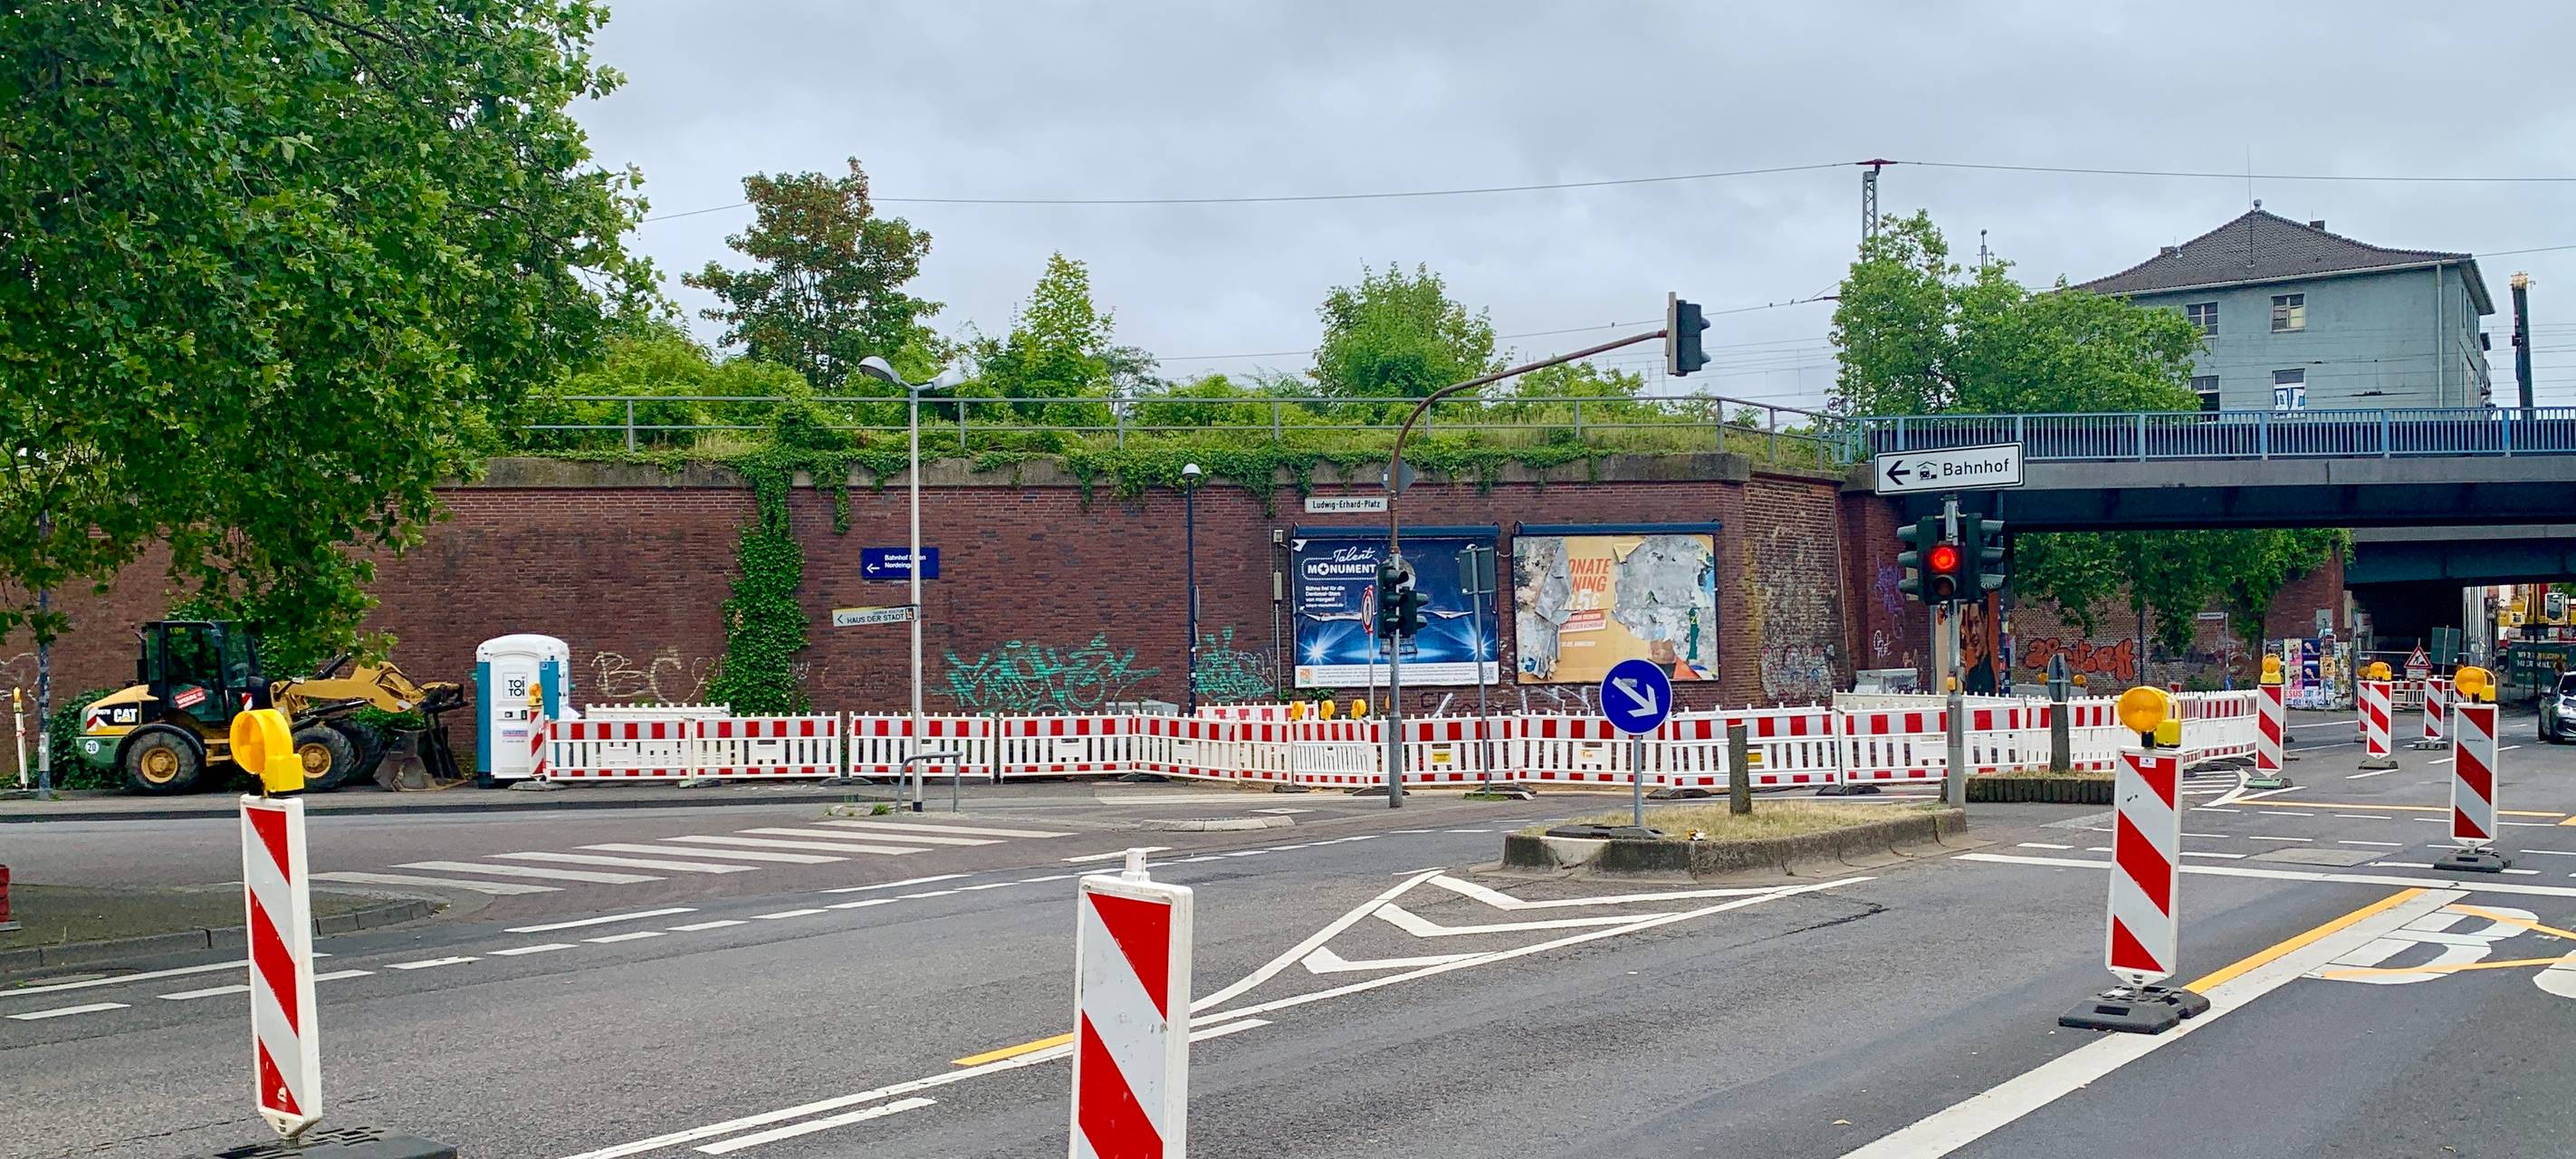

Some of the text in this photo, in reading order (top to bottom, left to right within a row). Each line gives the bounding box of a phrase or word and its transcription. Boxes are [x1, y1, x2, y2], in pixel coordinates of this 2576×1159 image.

[1943, 458, 2009, 476] Bahnhof
[1312, 500, 1381, 510] Ludwig-Erhard-Platz
[1333, 546, 1375, 562] Talent
[1307, 562, 1376, 576] MONUMENT
[1578, 589, 1593, 610] 5
[883, 613, 904, 621] STADT
[113, 708, 138, 723] CAT
[87, 742, 97, 752] 20
